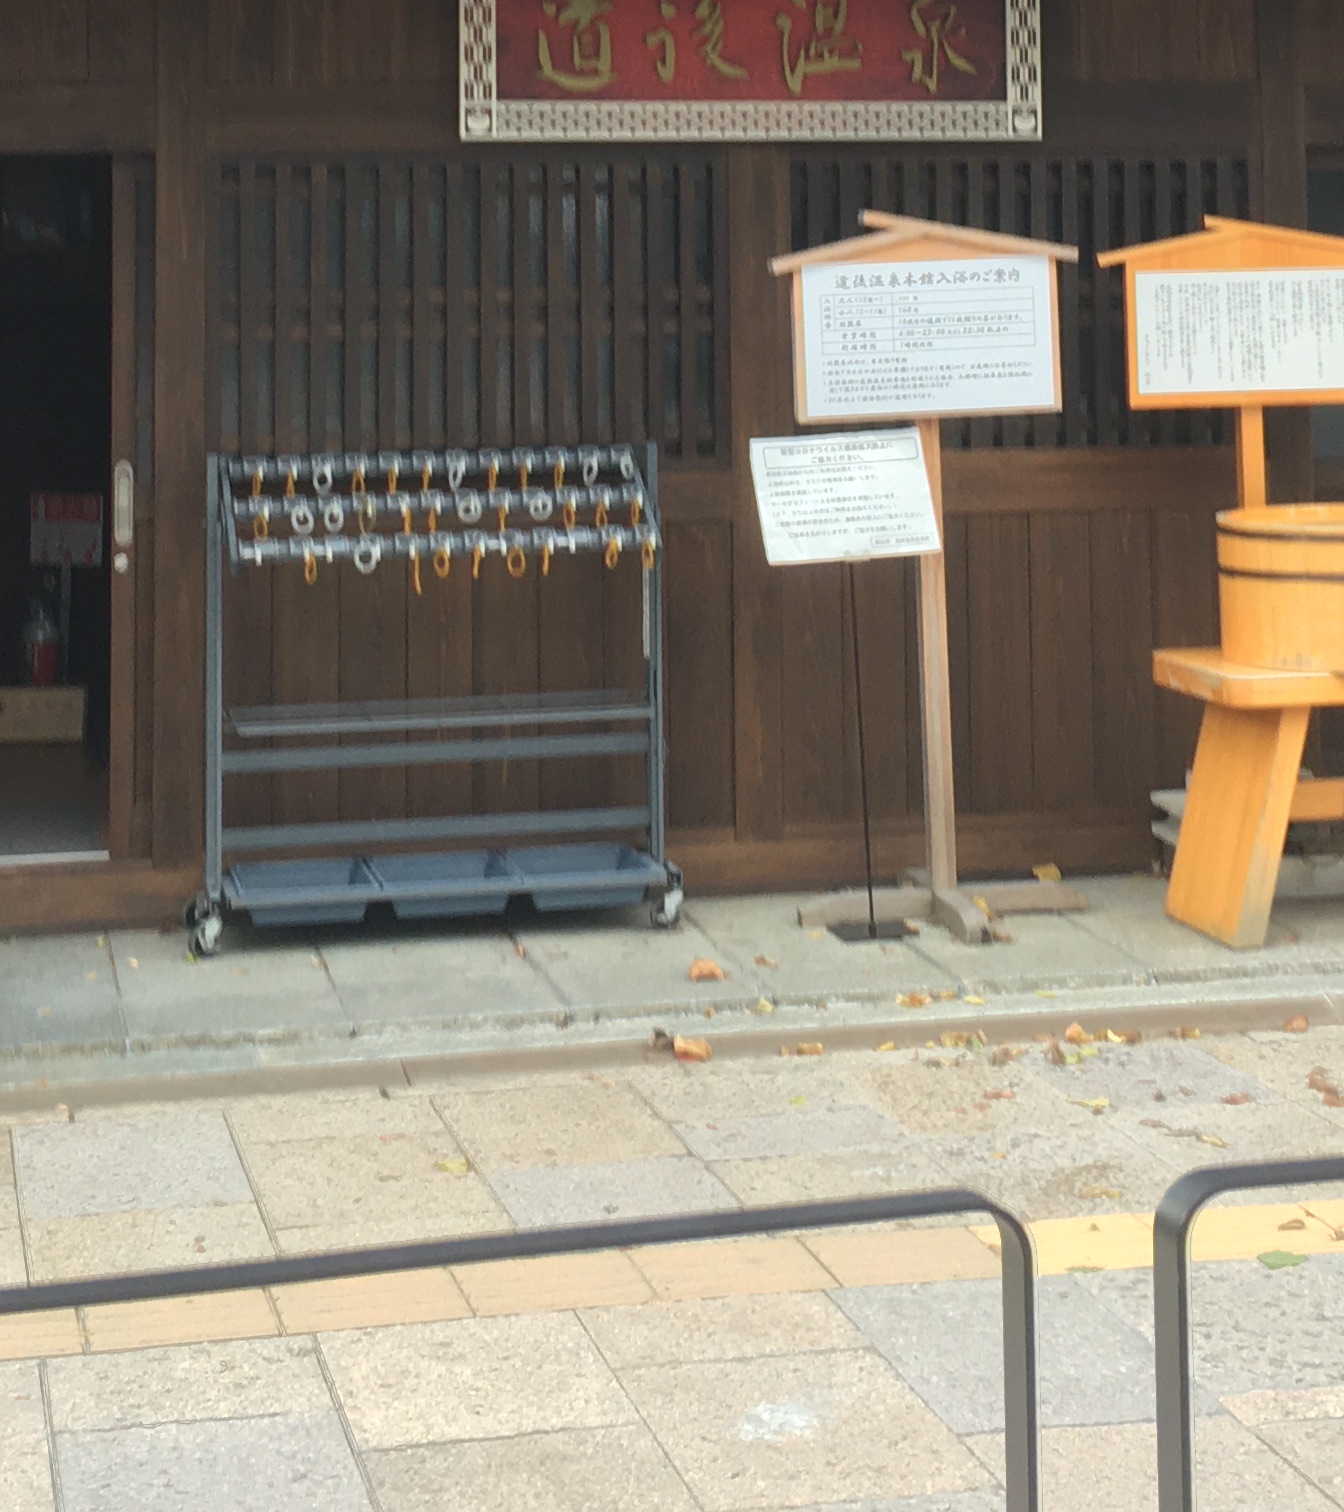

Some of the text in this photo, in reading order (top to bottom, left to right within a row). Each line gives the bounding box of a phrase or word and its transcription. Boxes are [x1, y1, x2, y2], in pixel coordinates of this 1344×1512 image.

[834, 267, 1021, 290] 道後温泉本館入浴のご案内
